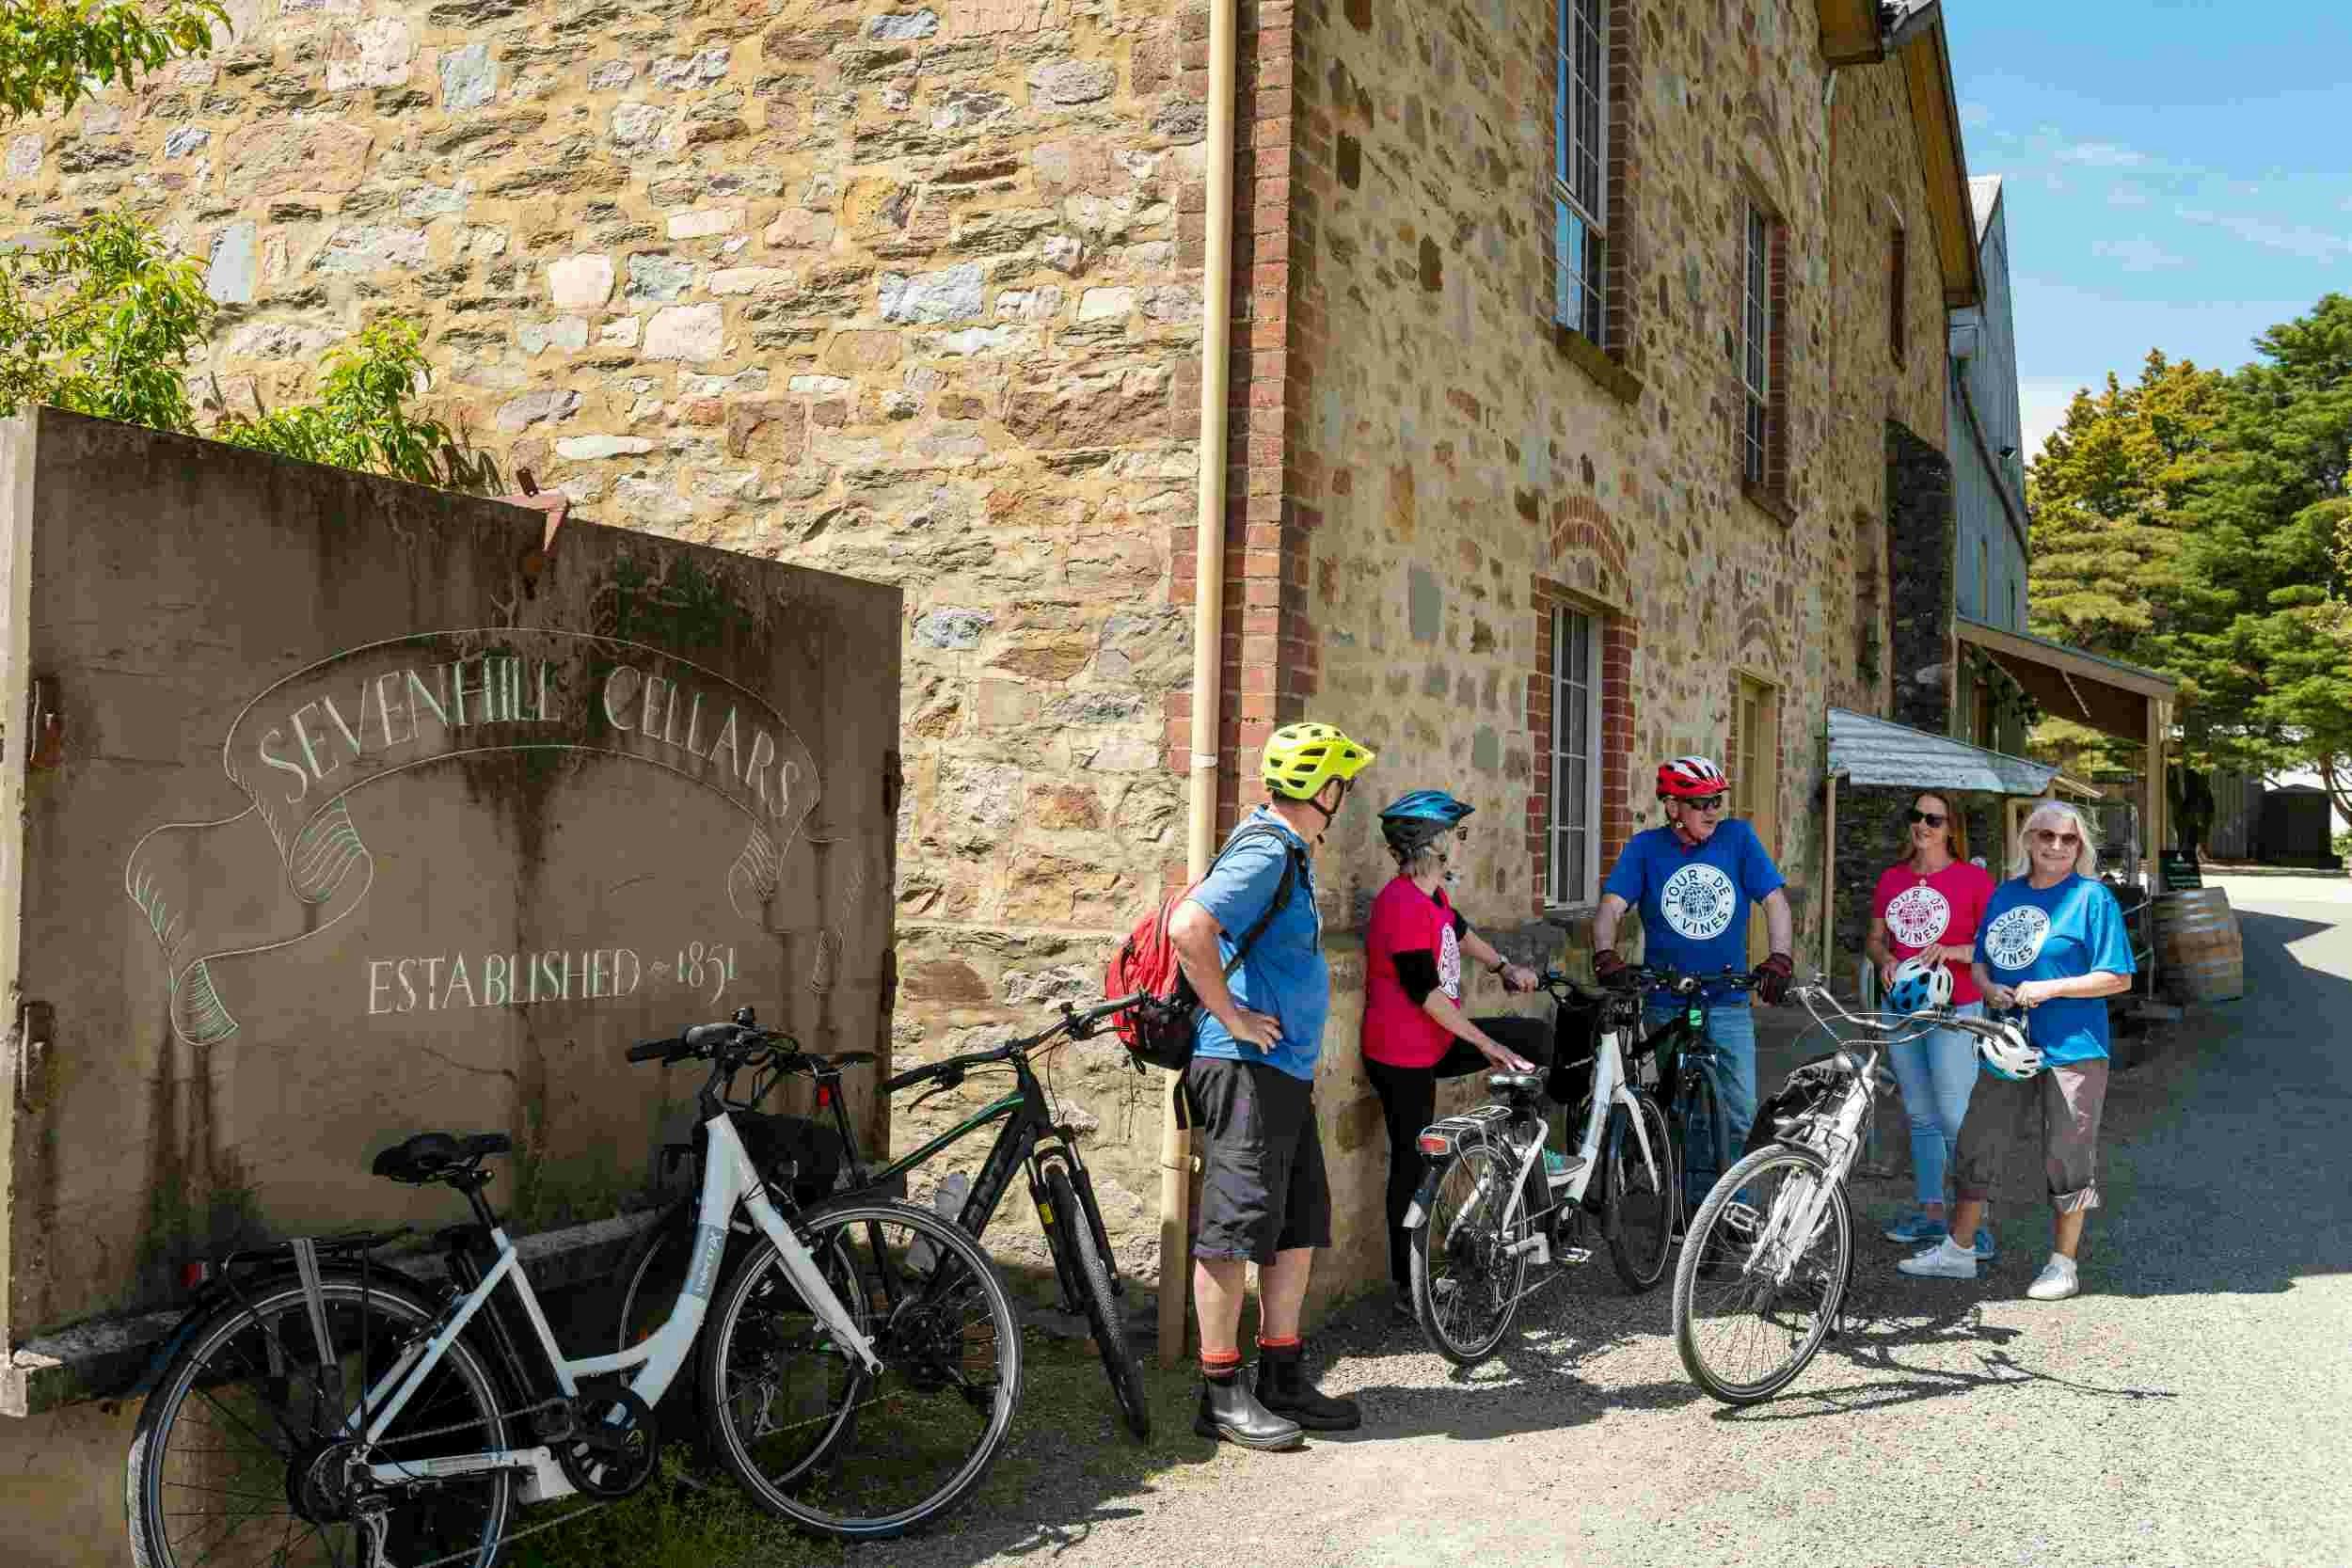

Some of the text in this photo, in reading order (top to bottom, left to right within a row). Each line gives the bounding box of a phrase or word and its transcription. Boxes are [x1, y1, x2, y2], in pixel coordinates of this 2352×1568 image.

[259, 656, 800, 817] SEVENHILL CELLARS
[1665, 869, 1732, 934] TOUR DE VINES
[1887, 890, 1920, 918] TOUR
[1900, 923, 1940, 943] VINES
[1990, 909, 2028, 934] TOUR
[1993, 943, 2033, 965] VINES
[367, 941, 739, 1015] ESTABLISHED 1851
